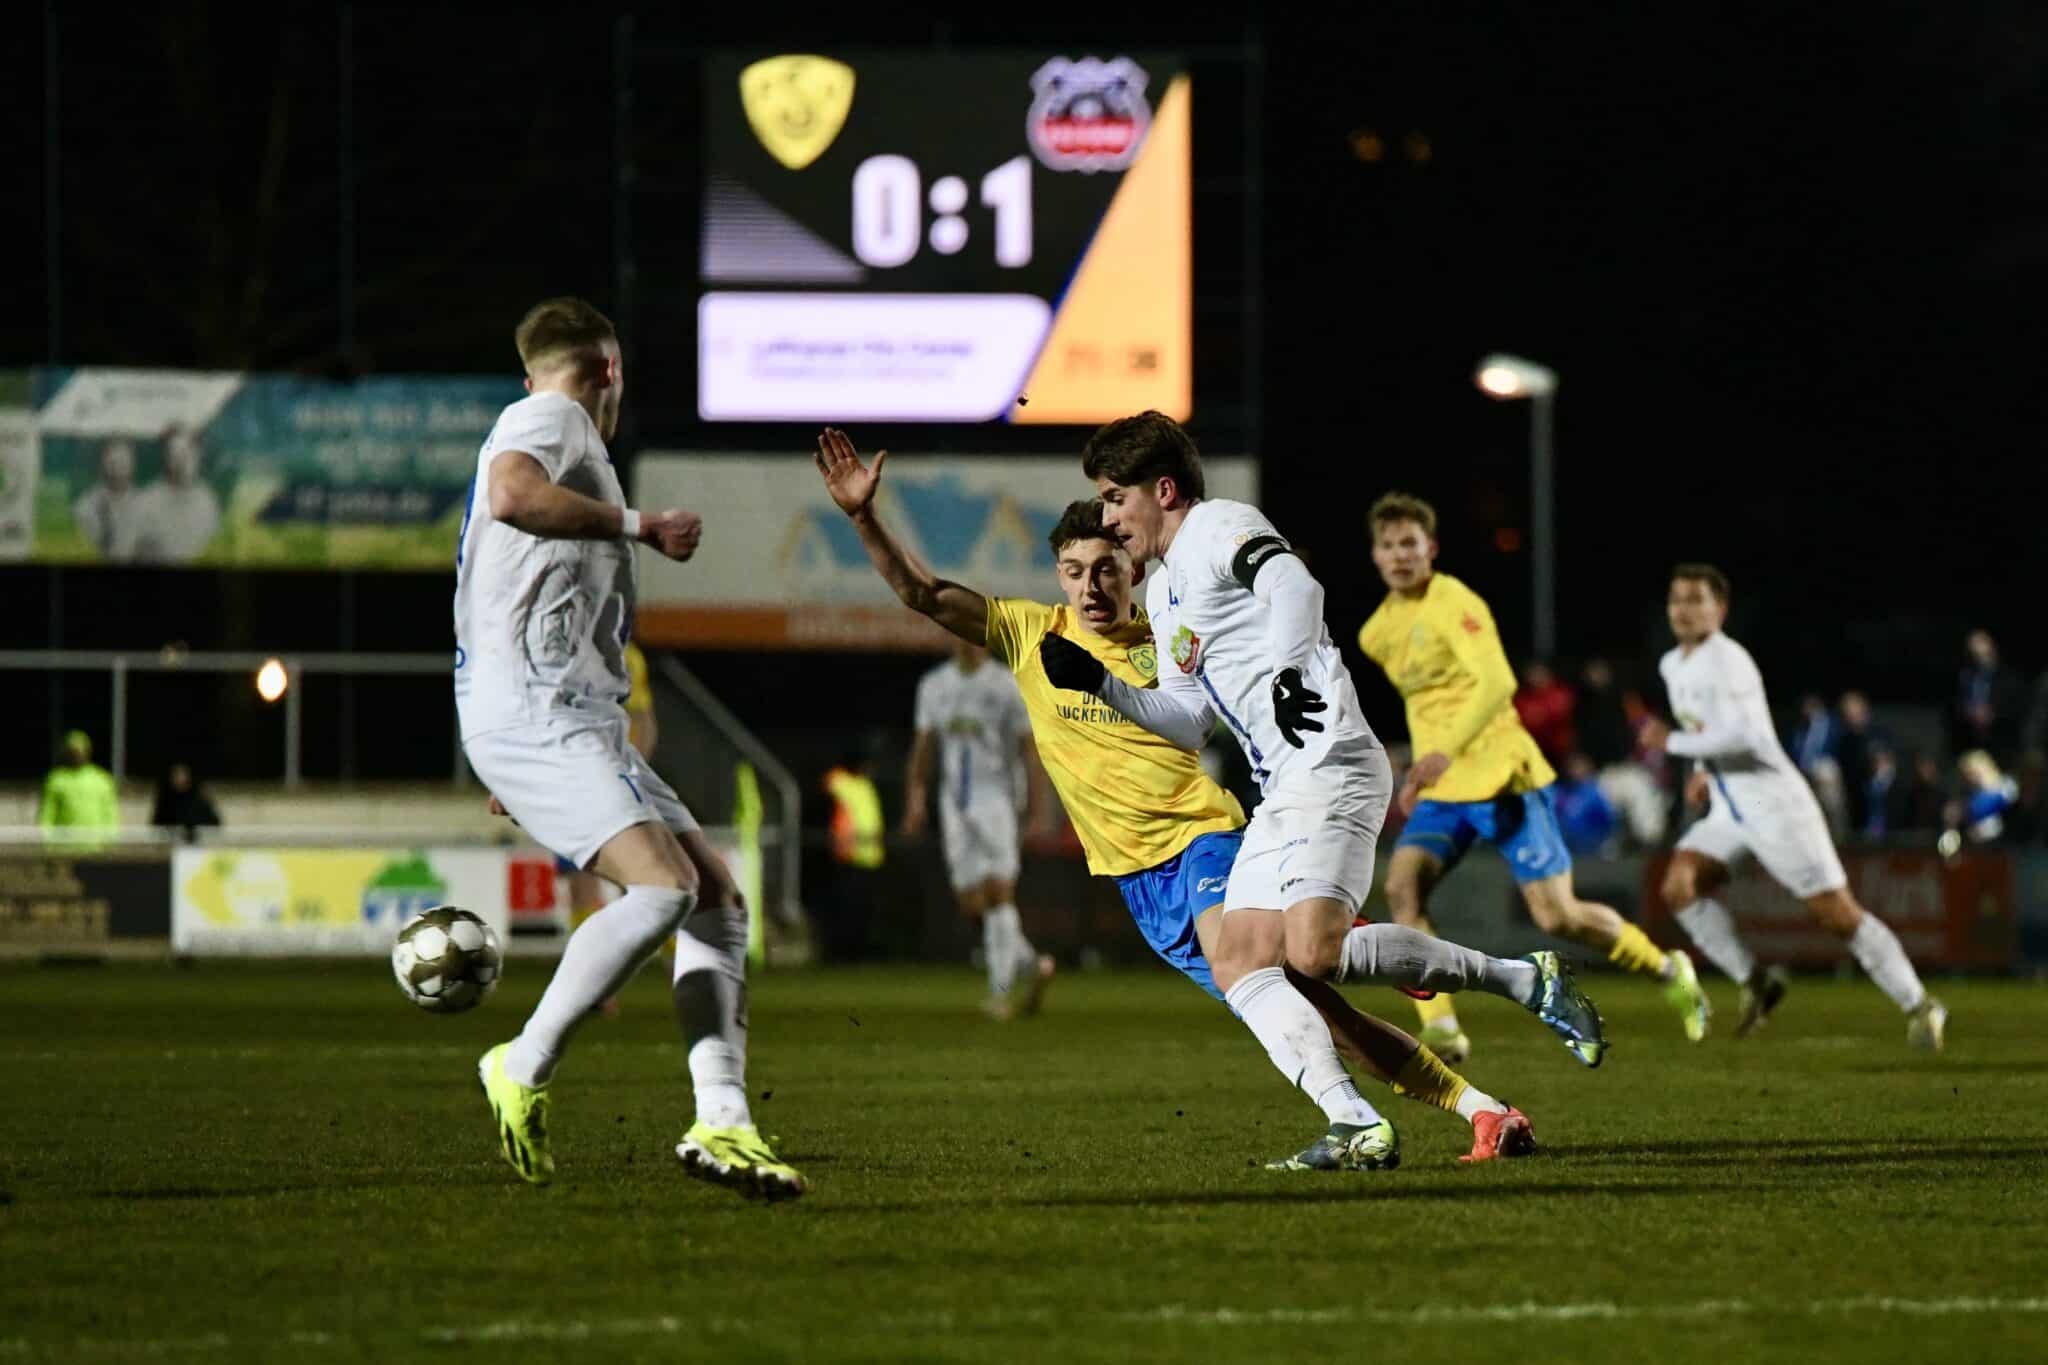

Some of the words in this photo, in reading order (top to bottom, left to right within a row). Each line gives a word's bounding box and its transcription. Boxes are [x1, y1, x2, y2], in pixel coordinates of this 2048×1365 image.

[852, 154, 1032, 268] 0:1
[1133, 649, 1154, 670] FS
[1082, 690, 1099, 705] DI
[1056, 704, 1131, 724] LUCKENWA
